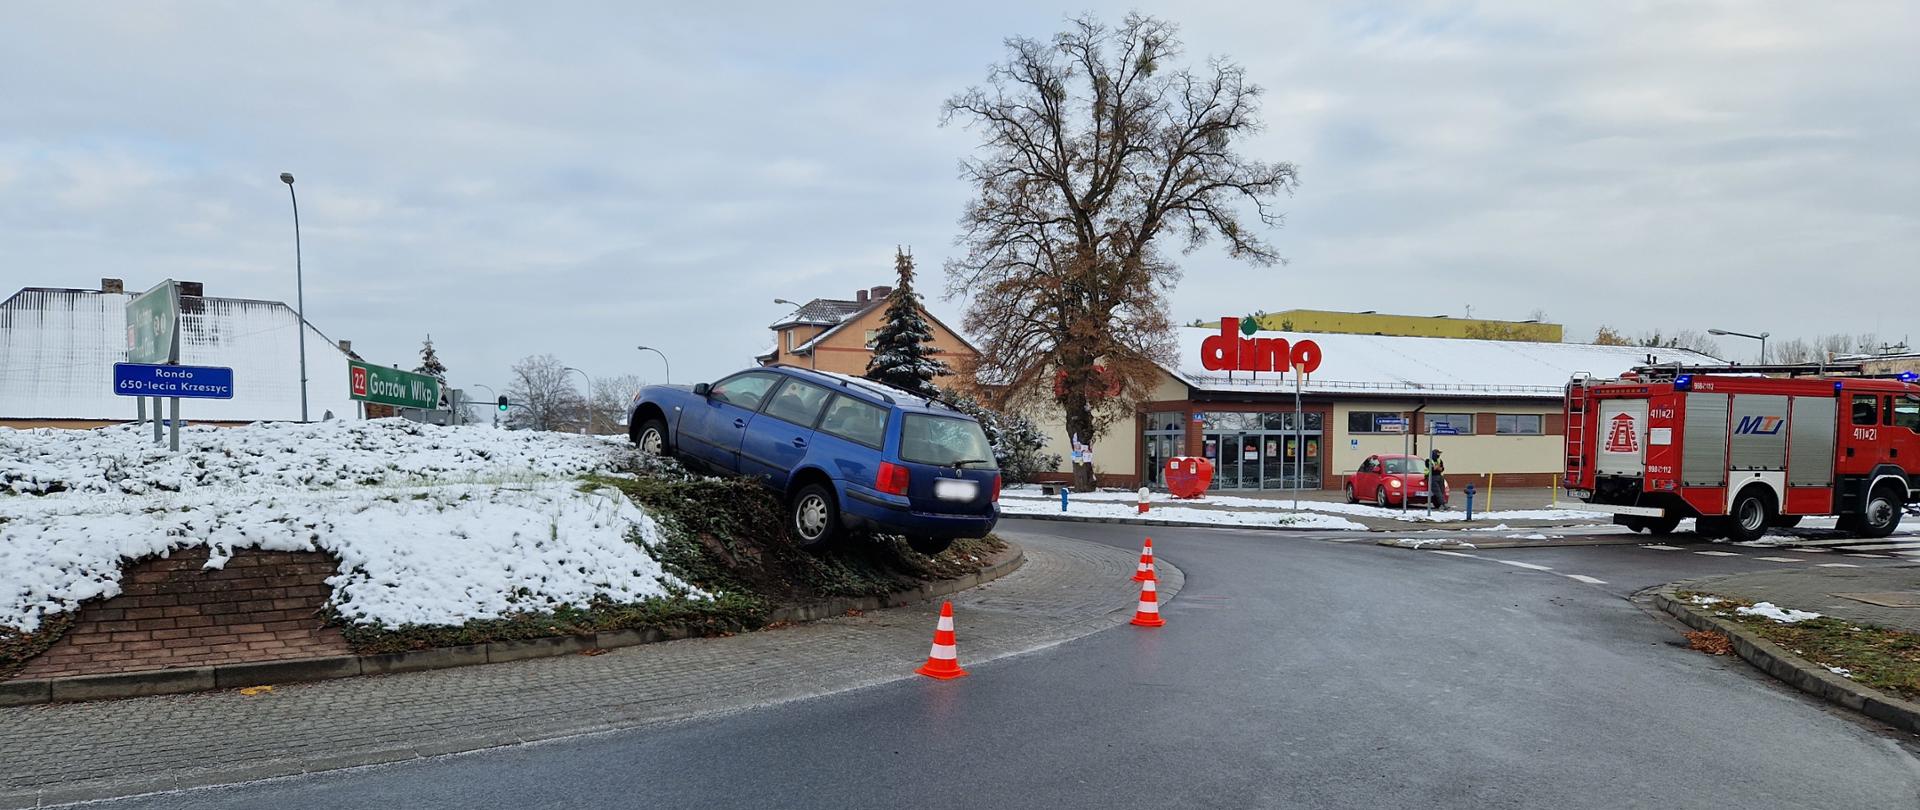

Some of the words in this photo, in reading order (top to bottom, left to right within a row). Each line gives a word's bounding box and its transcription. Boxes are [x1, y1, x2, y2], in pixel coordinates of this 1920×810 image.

[1200, 317, 1322, 373] dino
[155, 368, 194, 379] Rondo
[354, 373, 364, 390] 22
[120, 380, 177, 391] 650-lecia
[181, 382, 228, 394] Krzeszyc
[370, 372, 406, 399] Gorzów
[410, 379, 435, 407] Wlkp.
